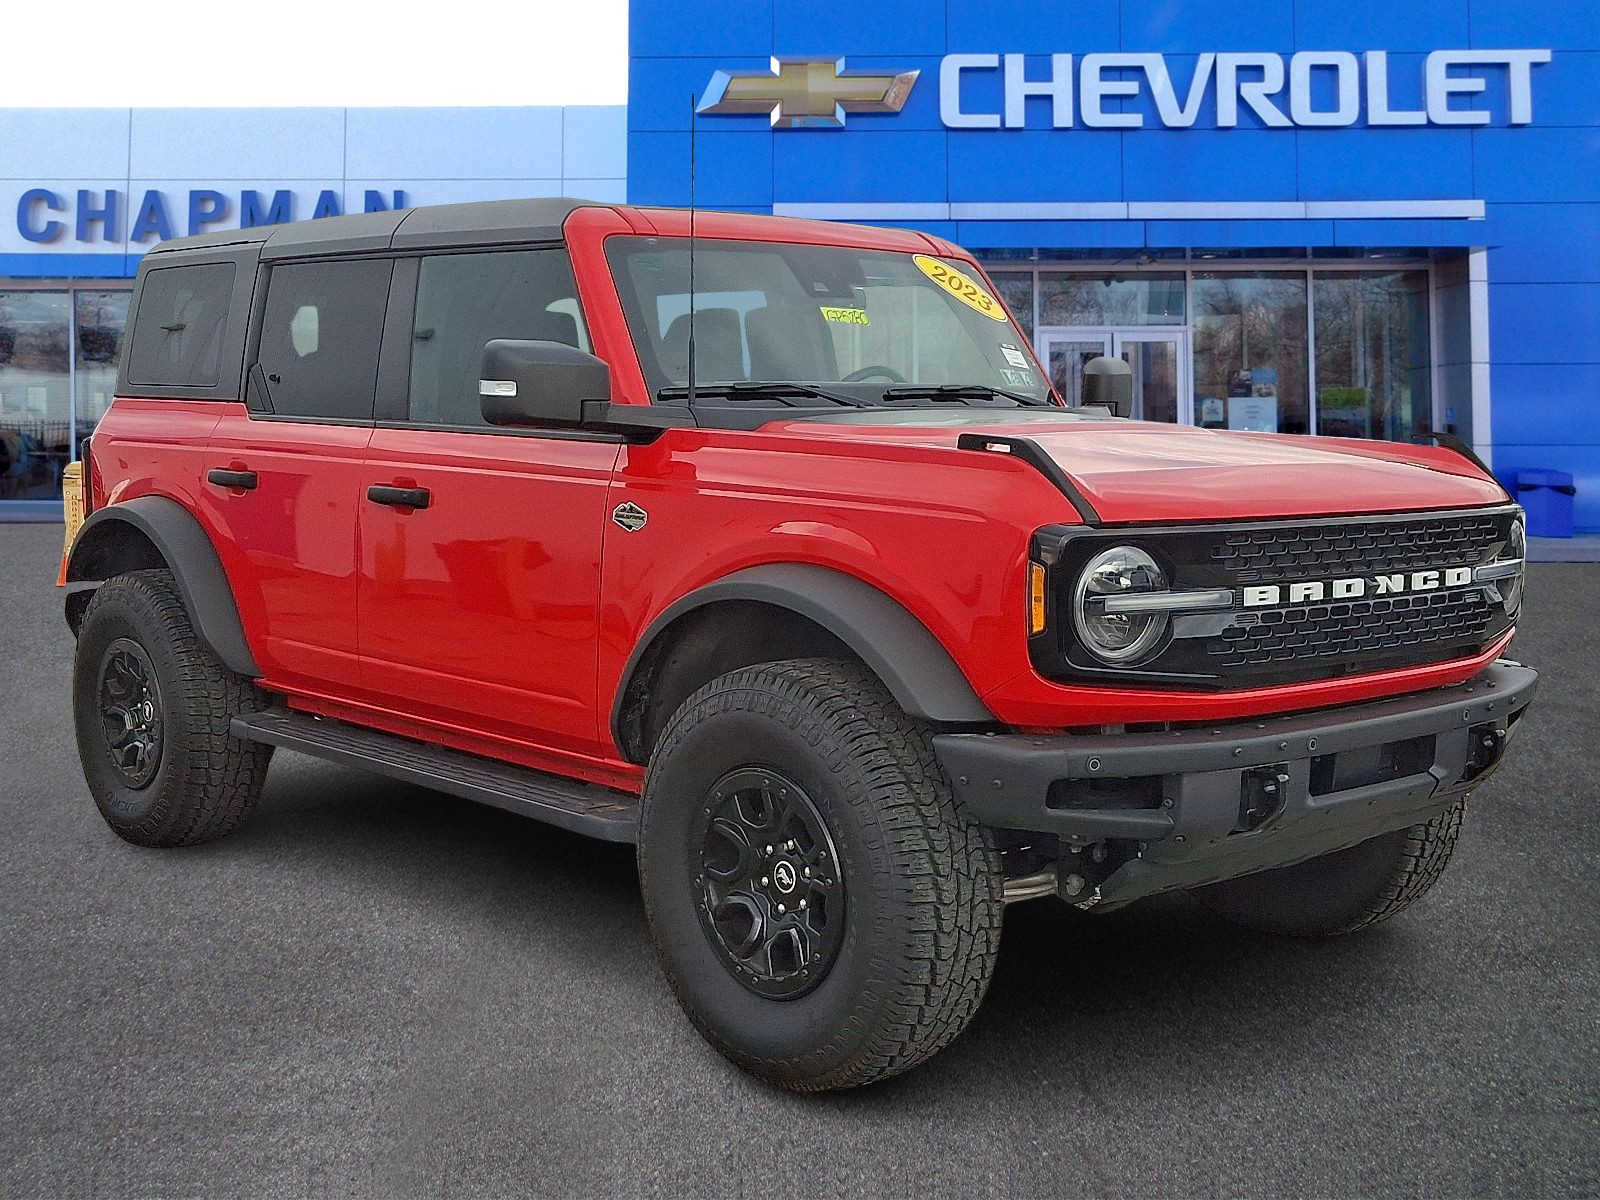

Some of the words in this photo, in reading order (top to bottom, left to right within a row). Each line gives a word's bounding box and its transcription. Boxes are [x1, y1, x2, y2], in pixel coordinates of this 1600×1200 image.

[939, 49, 1552, 128] CHEVROLET
[932, 265, 993, 311] 2023
[1243, 567, 1472, 606] BRONCO
